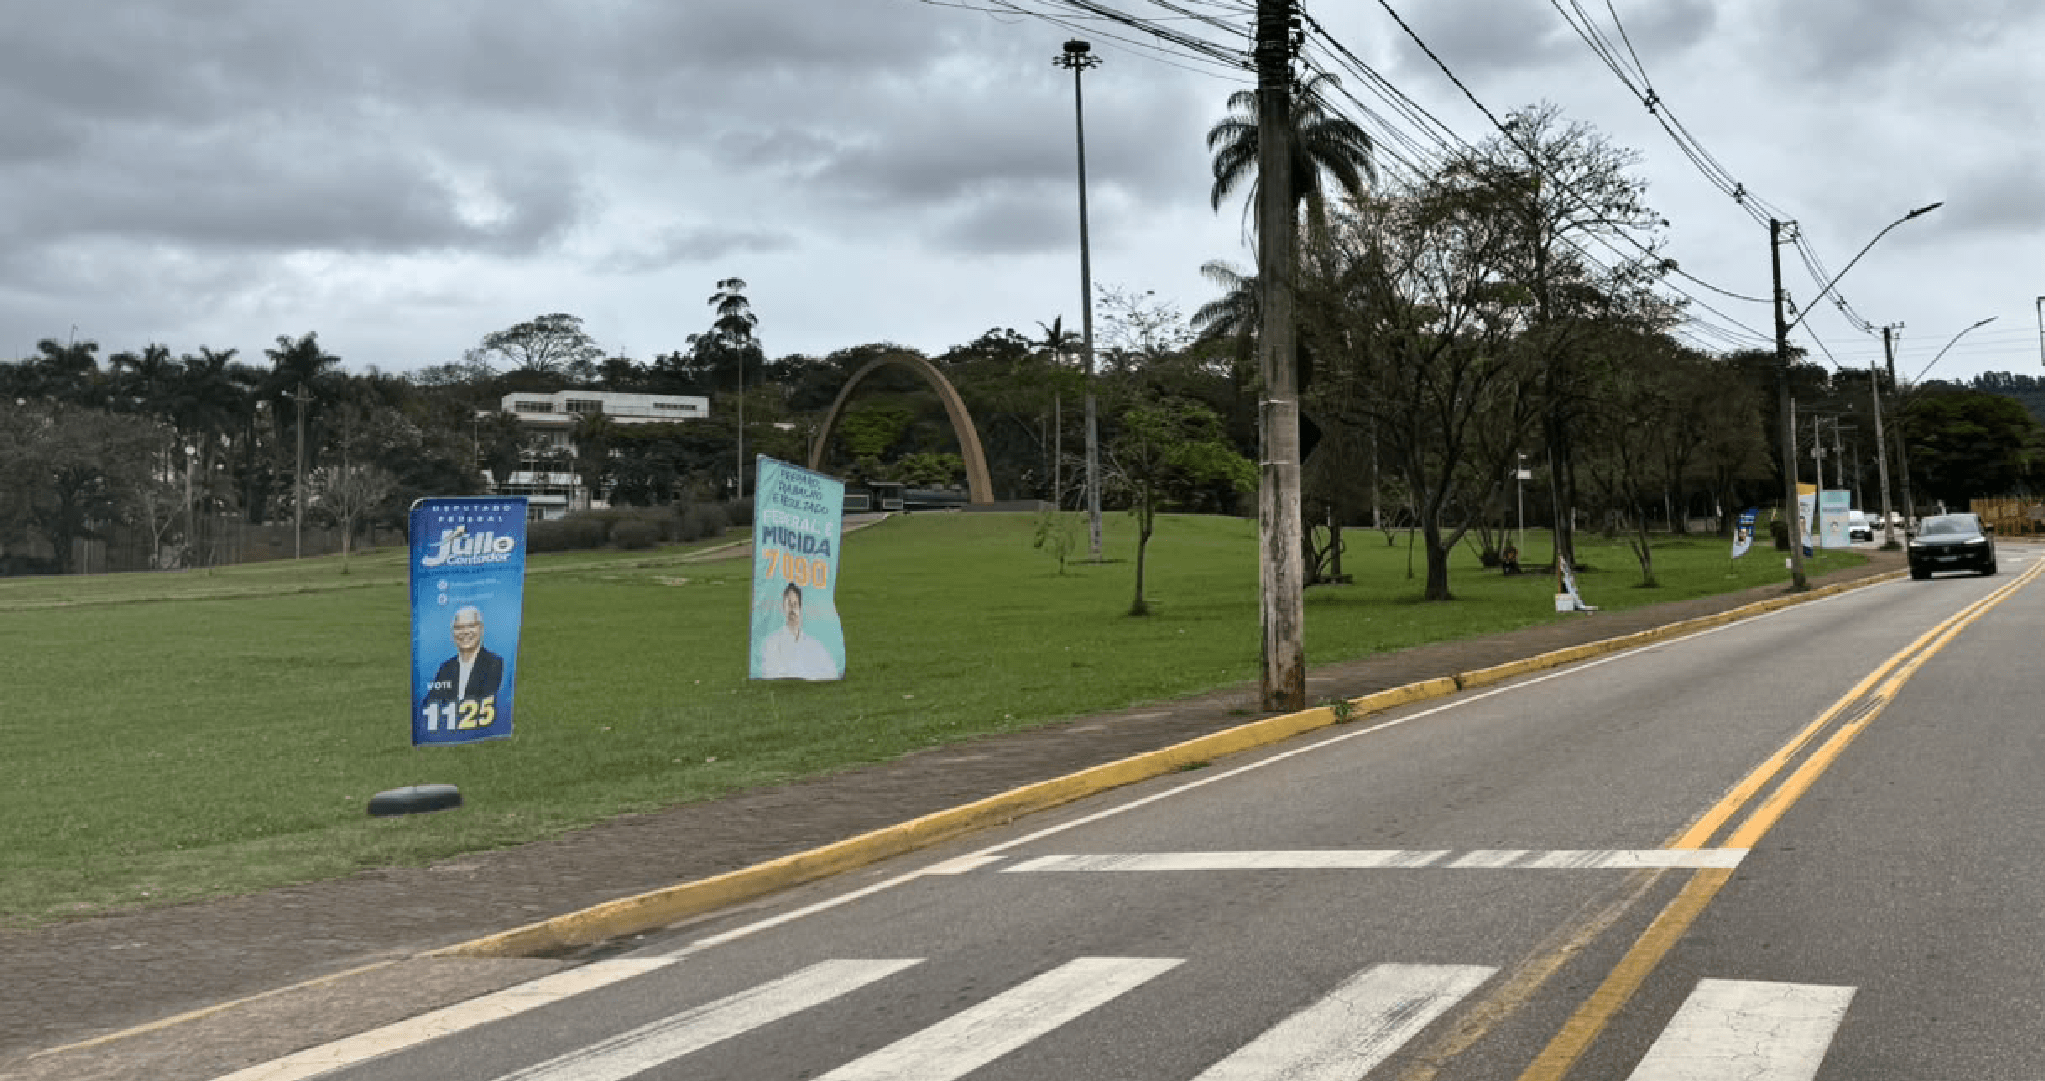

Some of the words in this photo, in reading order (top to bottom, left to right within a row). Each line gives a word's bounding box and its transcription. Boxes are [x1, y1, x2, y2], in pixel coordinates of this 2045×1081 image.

[761, 525, 831, 557] MUCIDA
[761, 548, 827, 590] 7090
[422, 694, 496, 732] 1125
